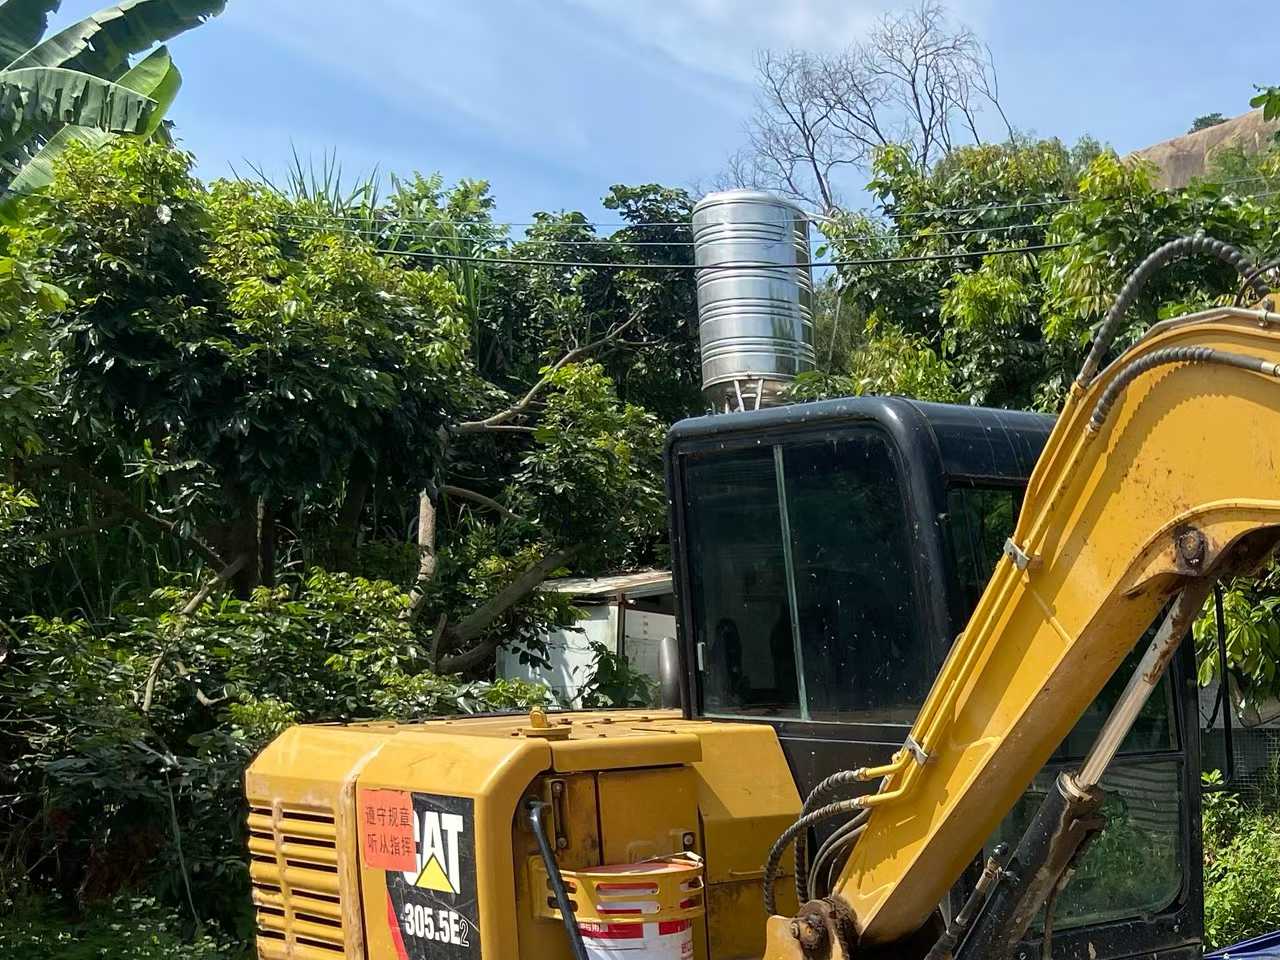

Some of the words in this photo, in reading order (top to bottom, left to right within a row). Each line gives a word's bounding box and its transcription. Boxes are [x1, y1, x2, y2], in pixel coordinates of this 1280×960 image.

[365, 806, 410, 827] 遵守规章
[367, 833, 413, 857] 听从指挥
[404, 902, 470, 948] 305.5E2
